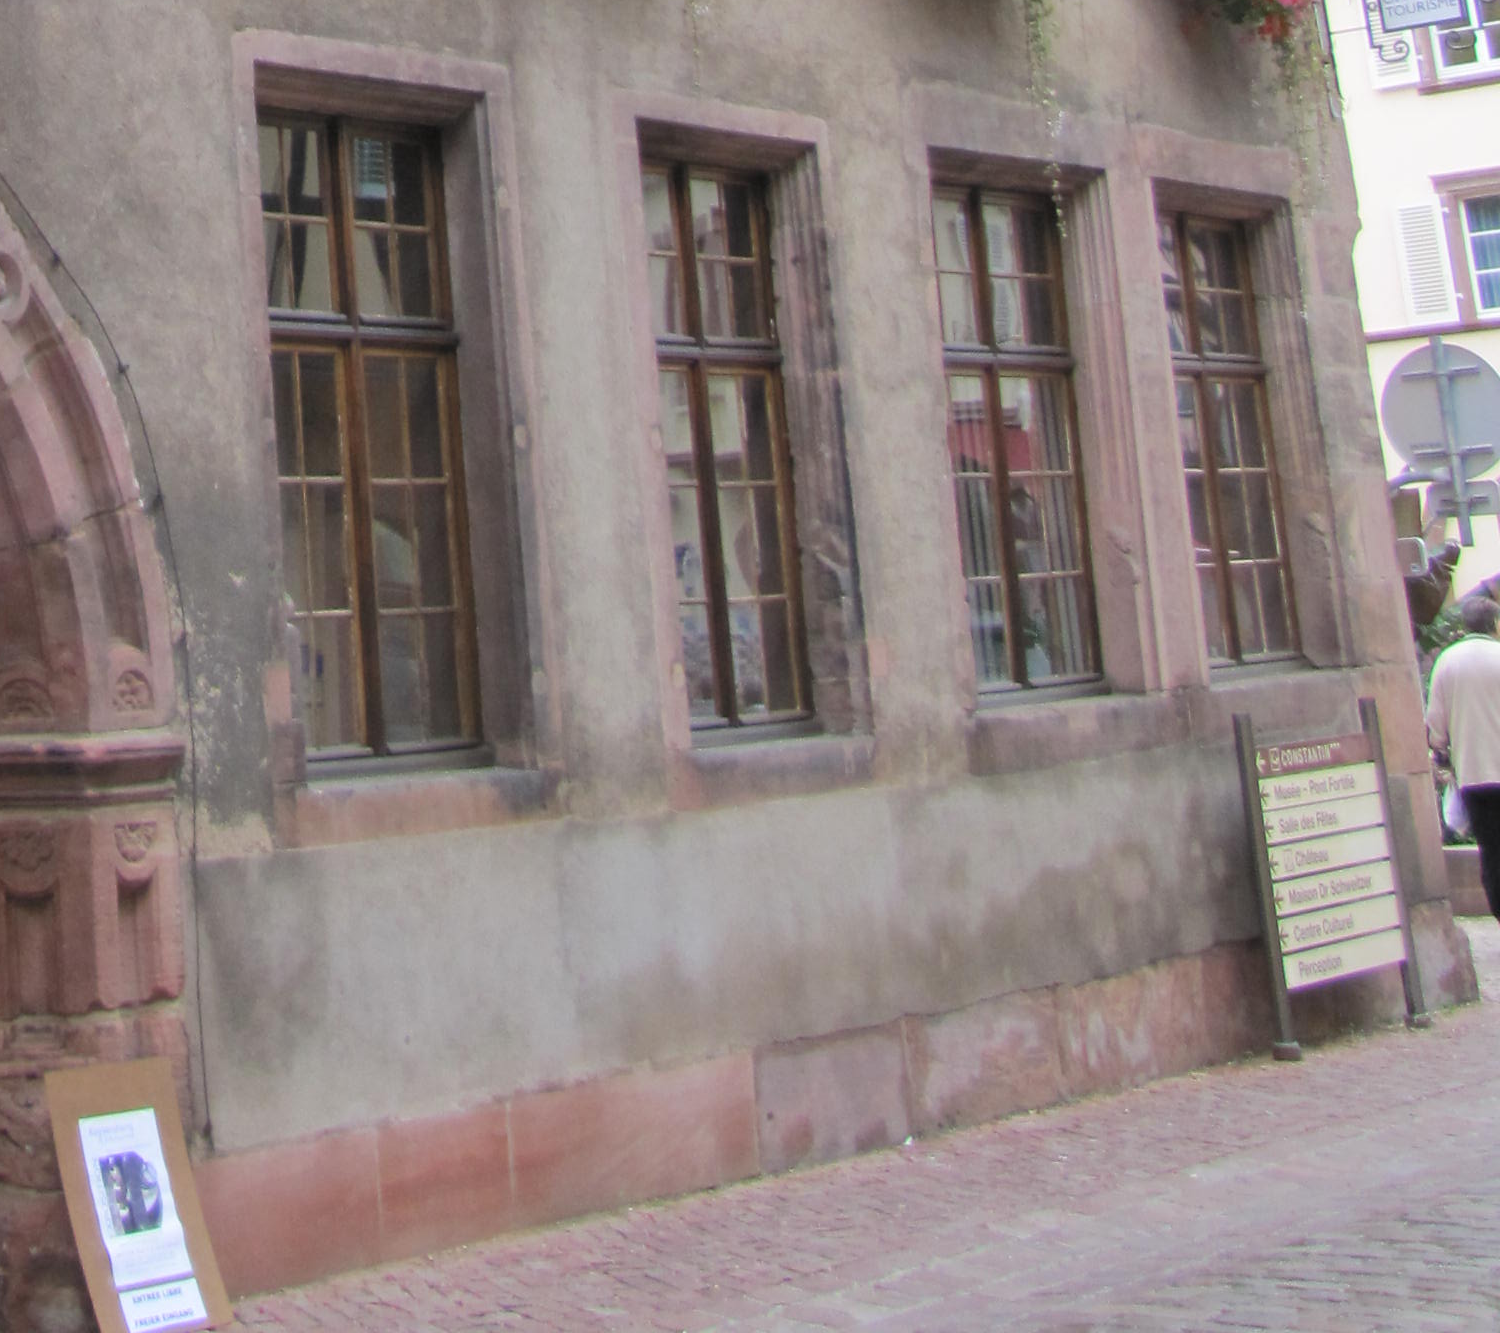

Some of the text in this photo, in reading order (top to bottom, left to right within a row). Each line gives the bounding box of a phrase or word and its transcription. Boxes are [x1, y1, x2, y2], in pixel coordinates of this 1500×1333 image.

[1273, 783, 1301, 801] Musée
[1308, 778, 1328, 794] Pont
[1279, 811, 1337, 834] Salle des Fêtes
[1295, 849, 1329, 867] Château
[1288, 887, 1318, 905] Maison
[1330, 875, 1372, 895] Schweitzer
[1293, 913, 1354, 942] Centre Culturel
